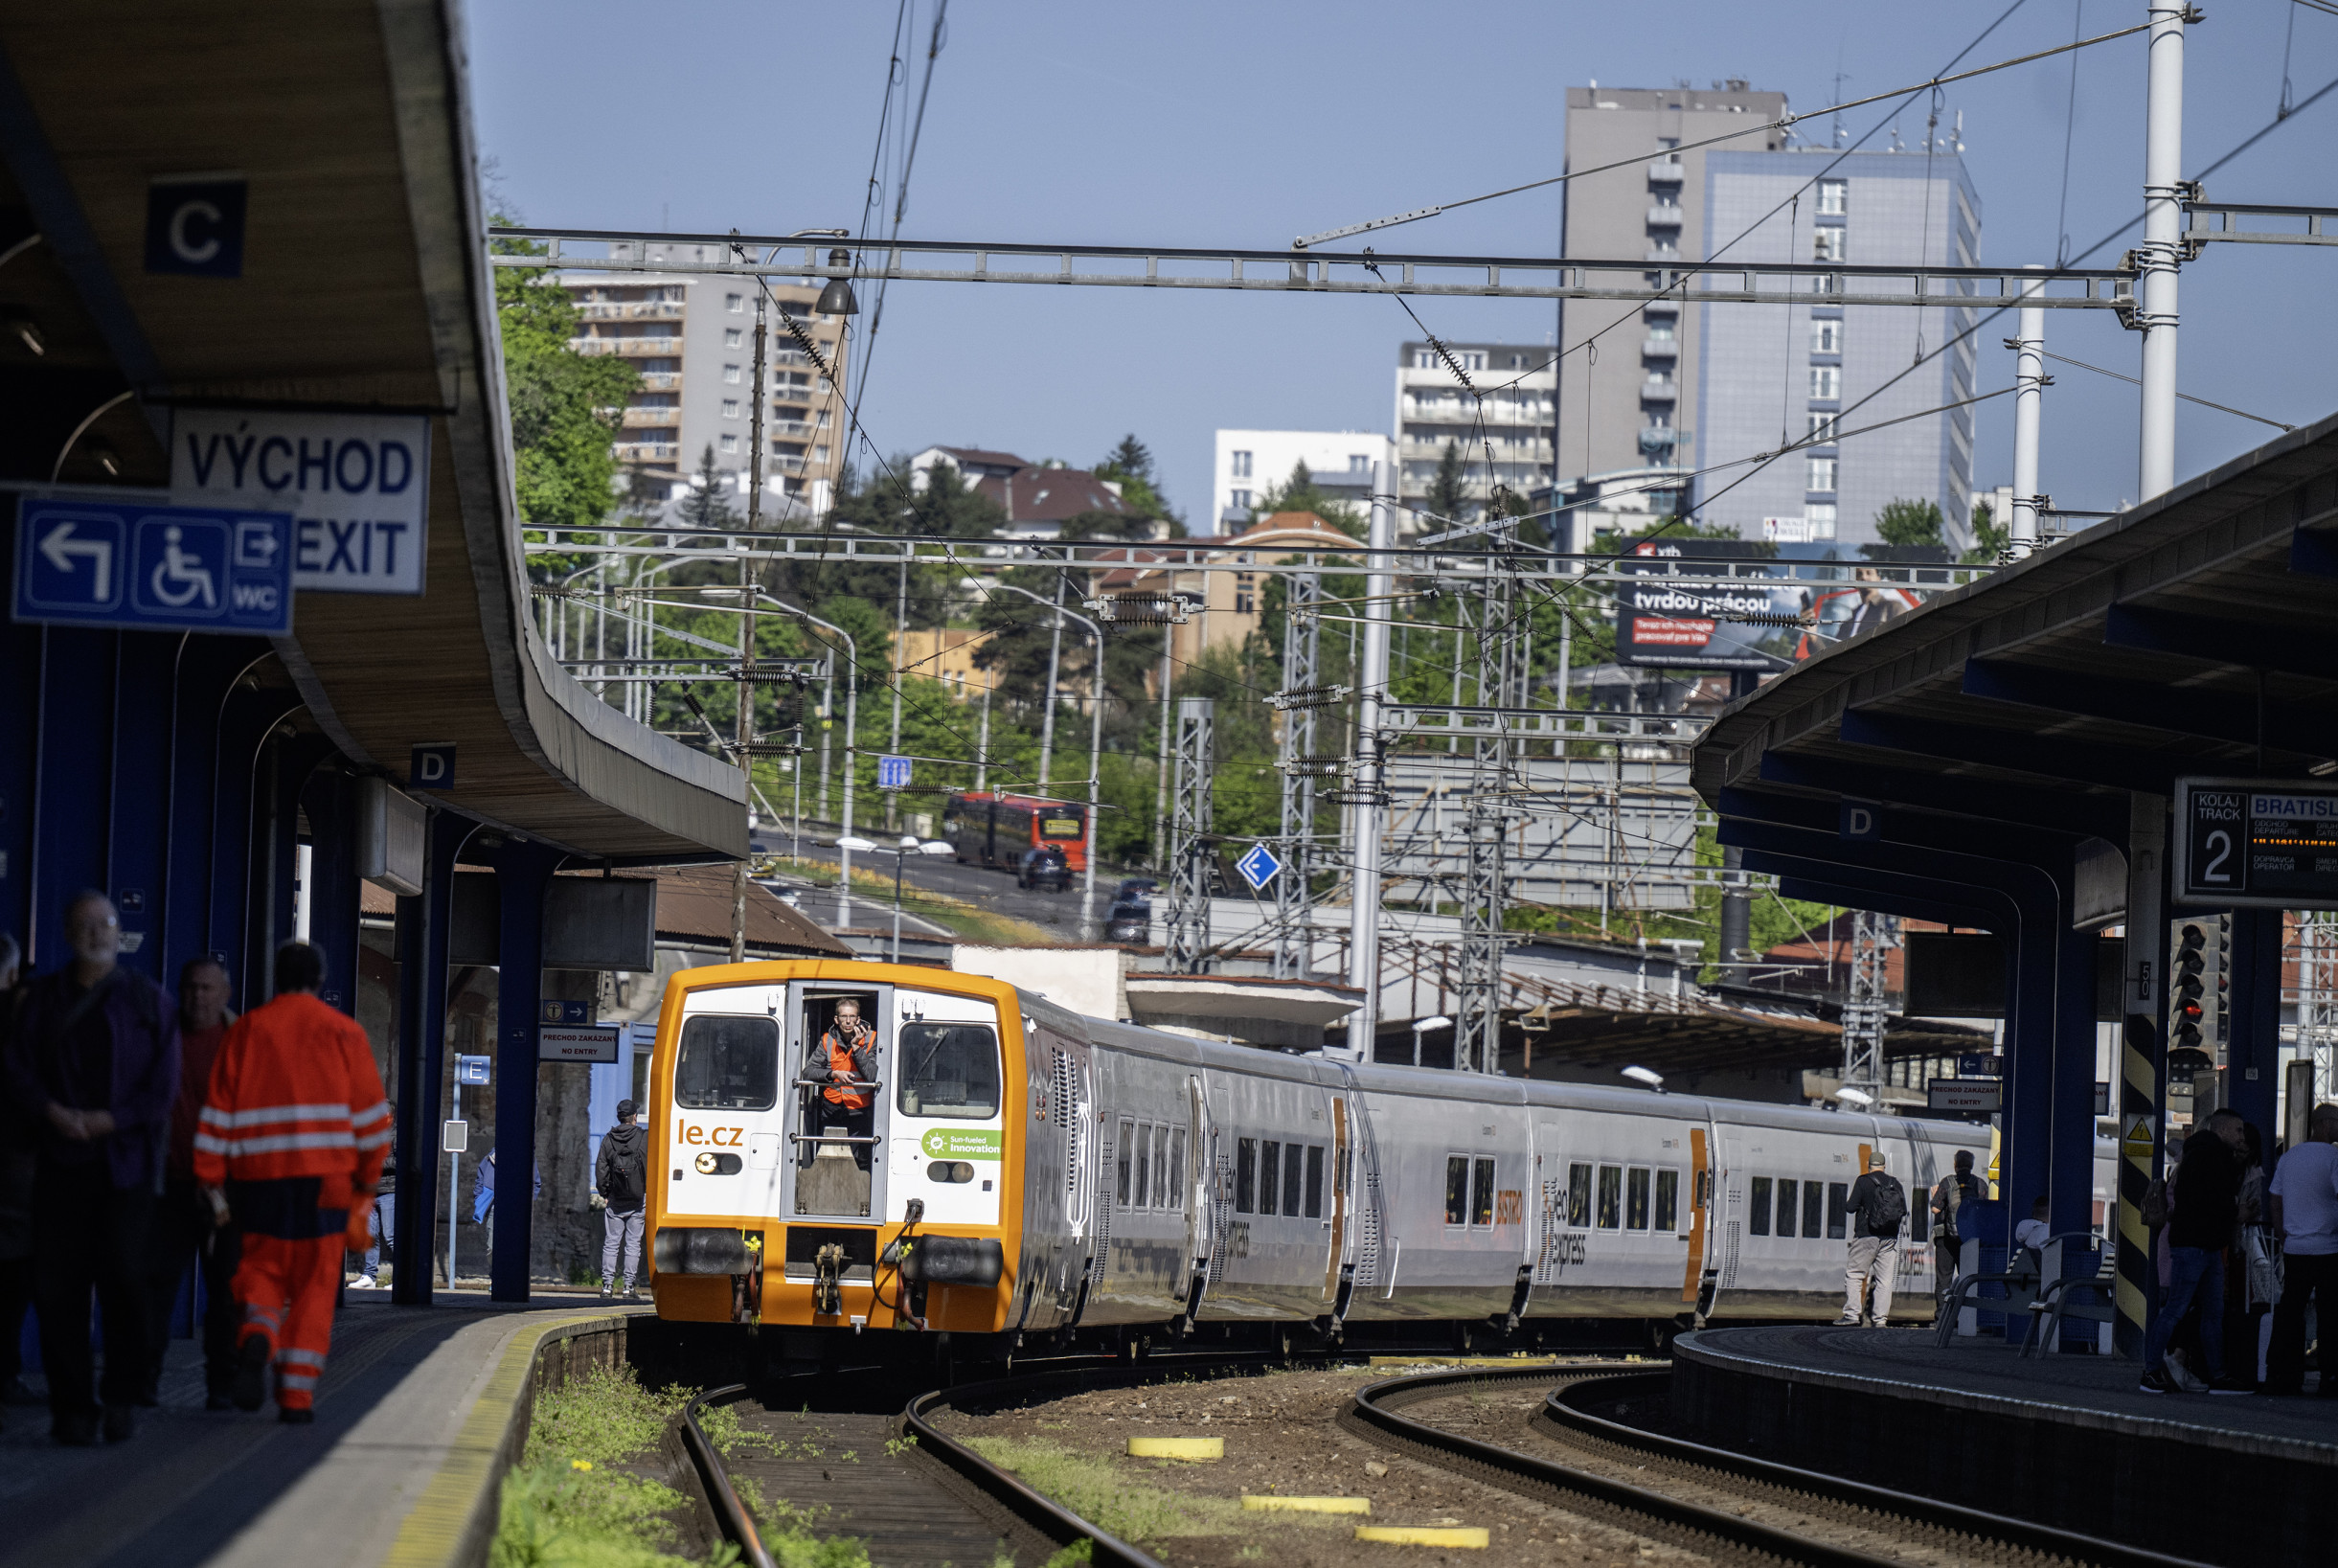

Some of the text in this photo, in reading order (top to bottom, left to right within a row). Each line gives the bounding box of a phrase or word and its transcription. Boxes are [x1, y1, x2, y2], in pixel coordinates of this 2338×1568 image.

[168, 199, 223, 264] C
[187, 420, 414, 495] VÝCHOD
[295, 518, 408, 578] EXIT
[232, 583, 279, 612] WC
[1634, 591, 1771, 615] tvrdou prácou
[420, 752, 445, 782] D
[1850, 807, 1873, 835] D
[2198, 807, 2241, 820] TRACK
[2255, 798, 2338, 816] BRATISL
[2204, 829, 2232, 882] 2
[2253, 862, 2295, 872] OPERATOR
[543, 1034, 578, 1042] PRECHOD
[469, 1061, 483, 1079] E
[678, 1118, 744, 1147] le.cz
[949, 1135, 987, 1145] Sun-fueled
[949, 1143, 1001, 1154] Innovation
[1497, 1190, 1523, 1225] BISTRO
